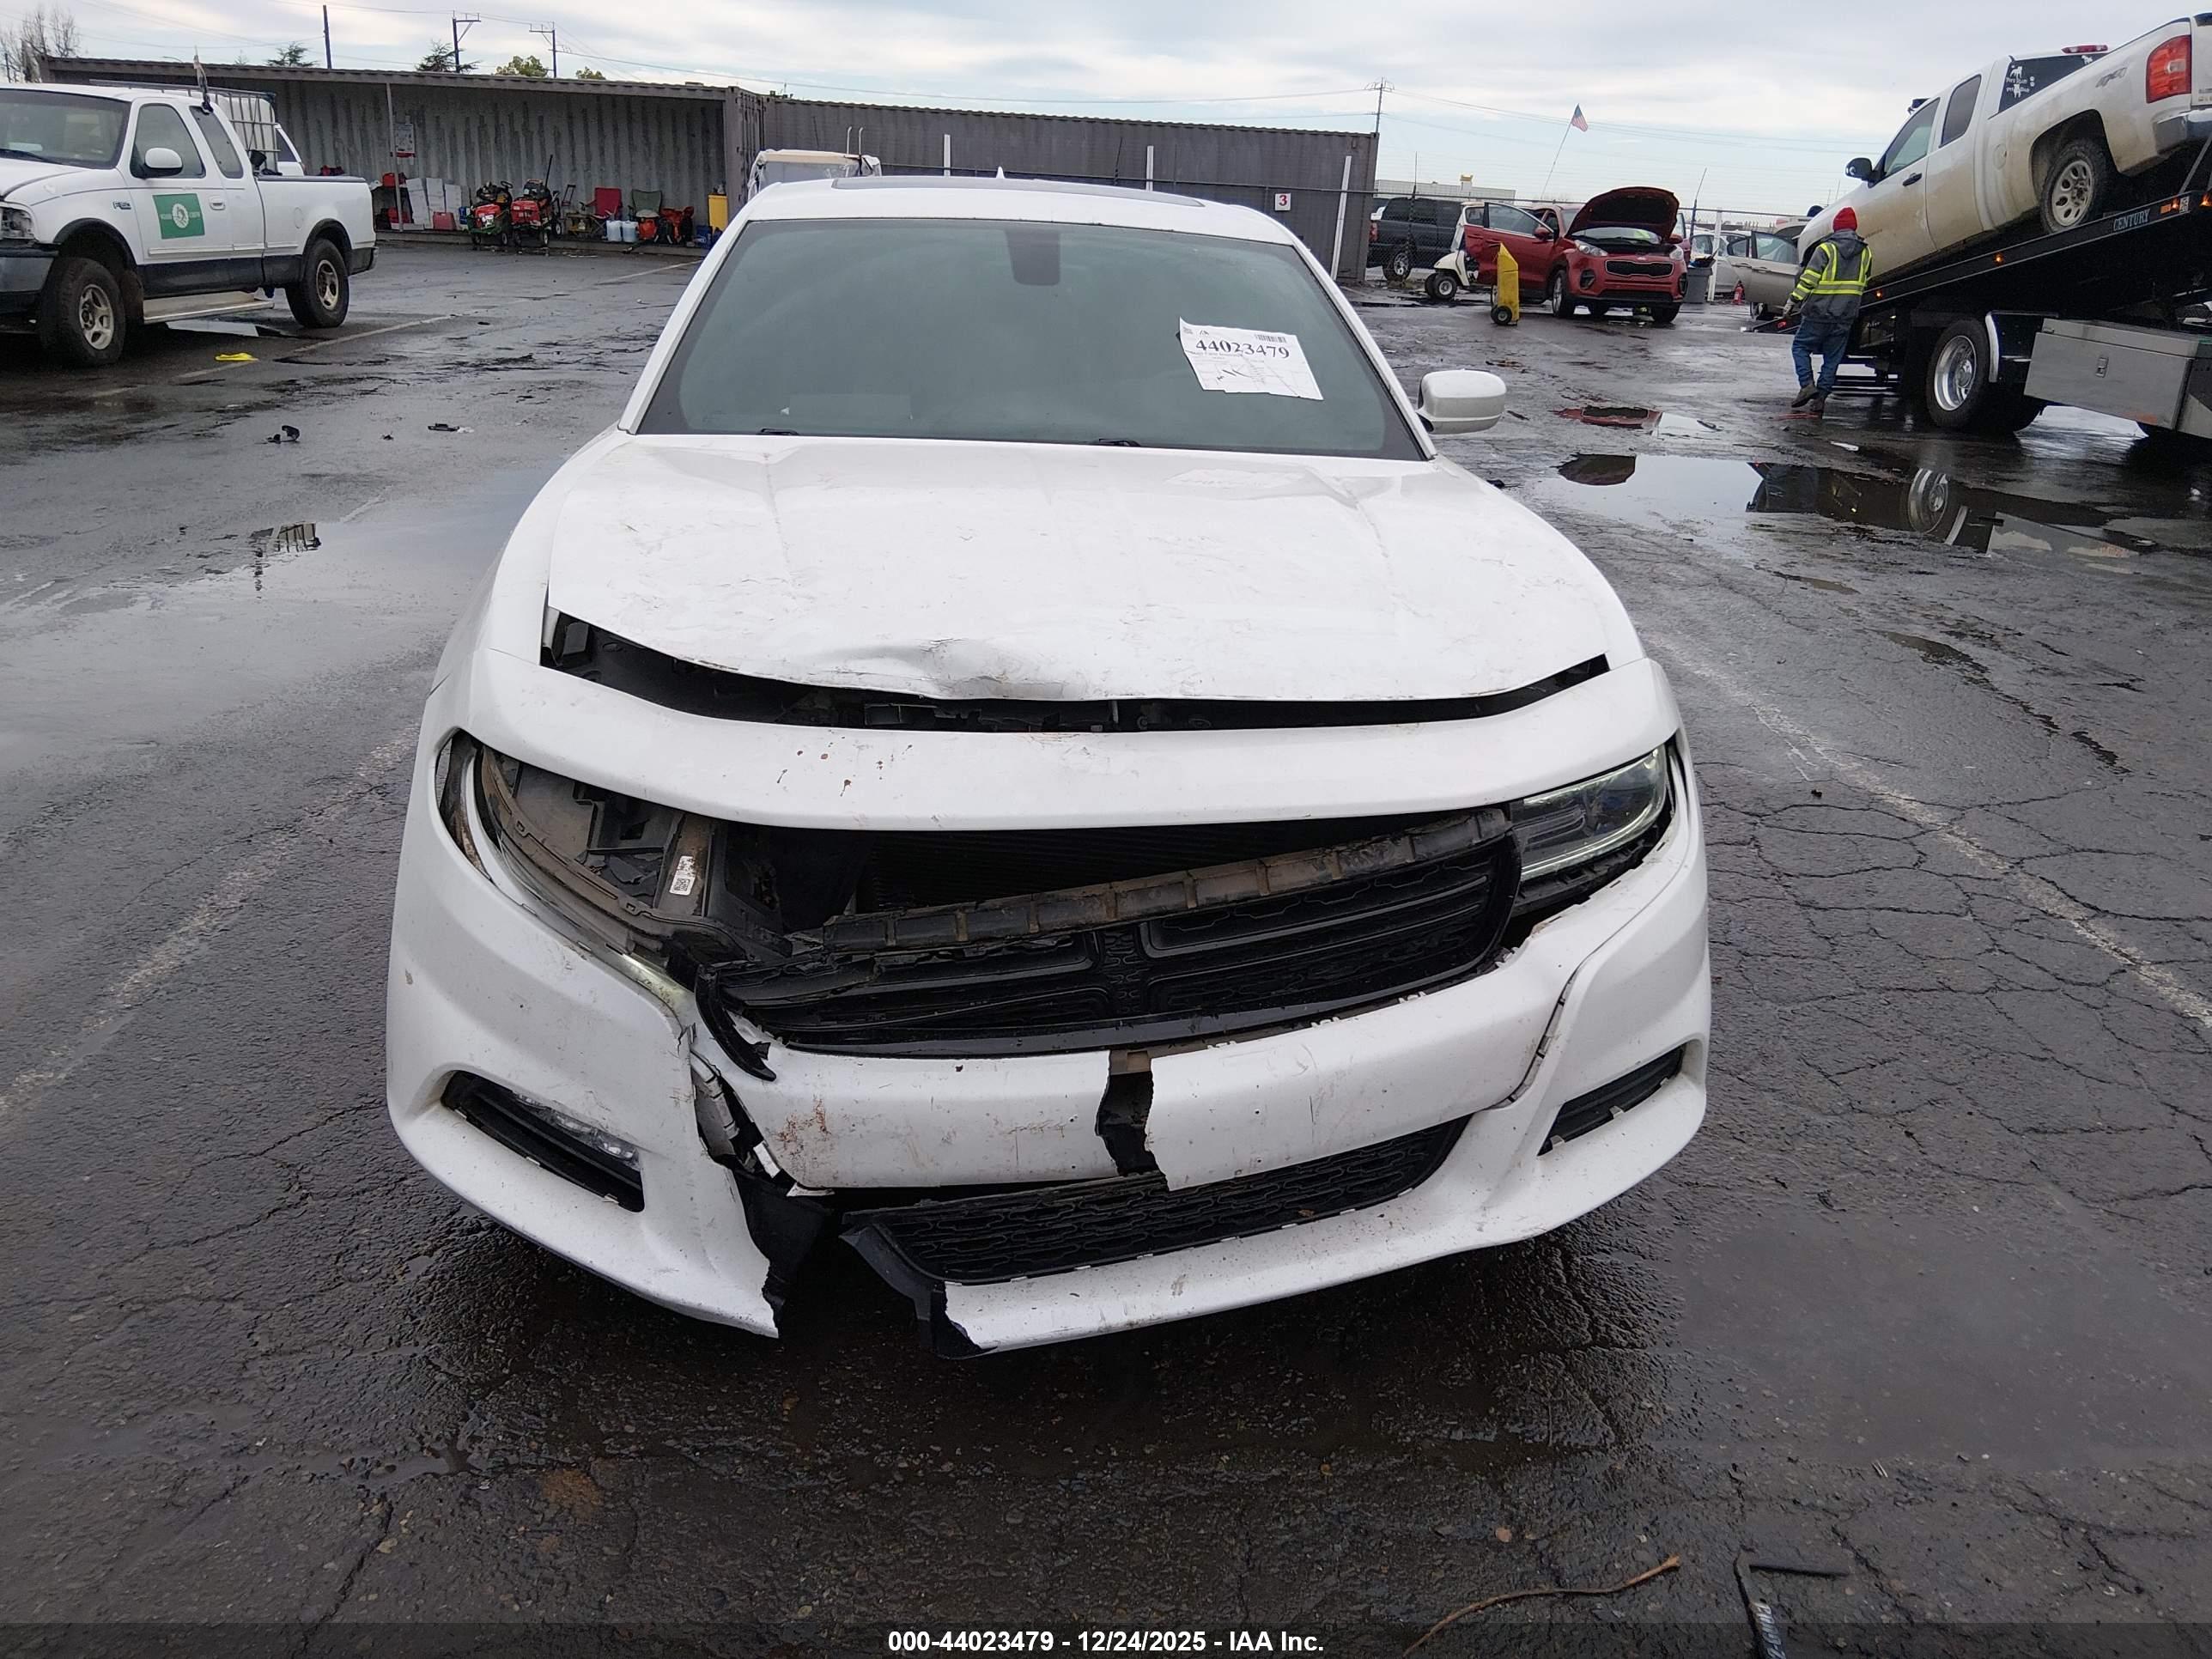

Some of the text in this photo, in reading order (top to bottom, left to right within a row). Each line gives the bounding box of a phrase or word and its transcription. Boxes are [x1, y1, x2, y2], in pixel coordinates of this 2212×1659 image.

[1279, 194, 1288, 206] 3
[2113, 208, 2150, 231] CENTURY
[1196, 339, 1290, 359] 44023479
